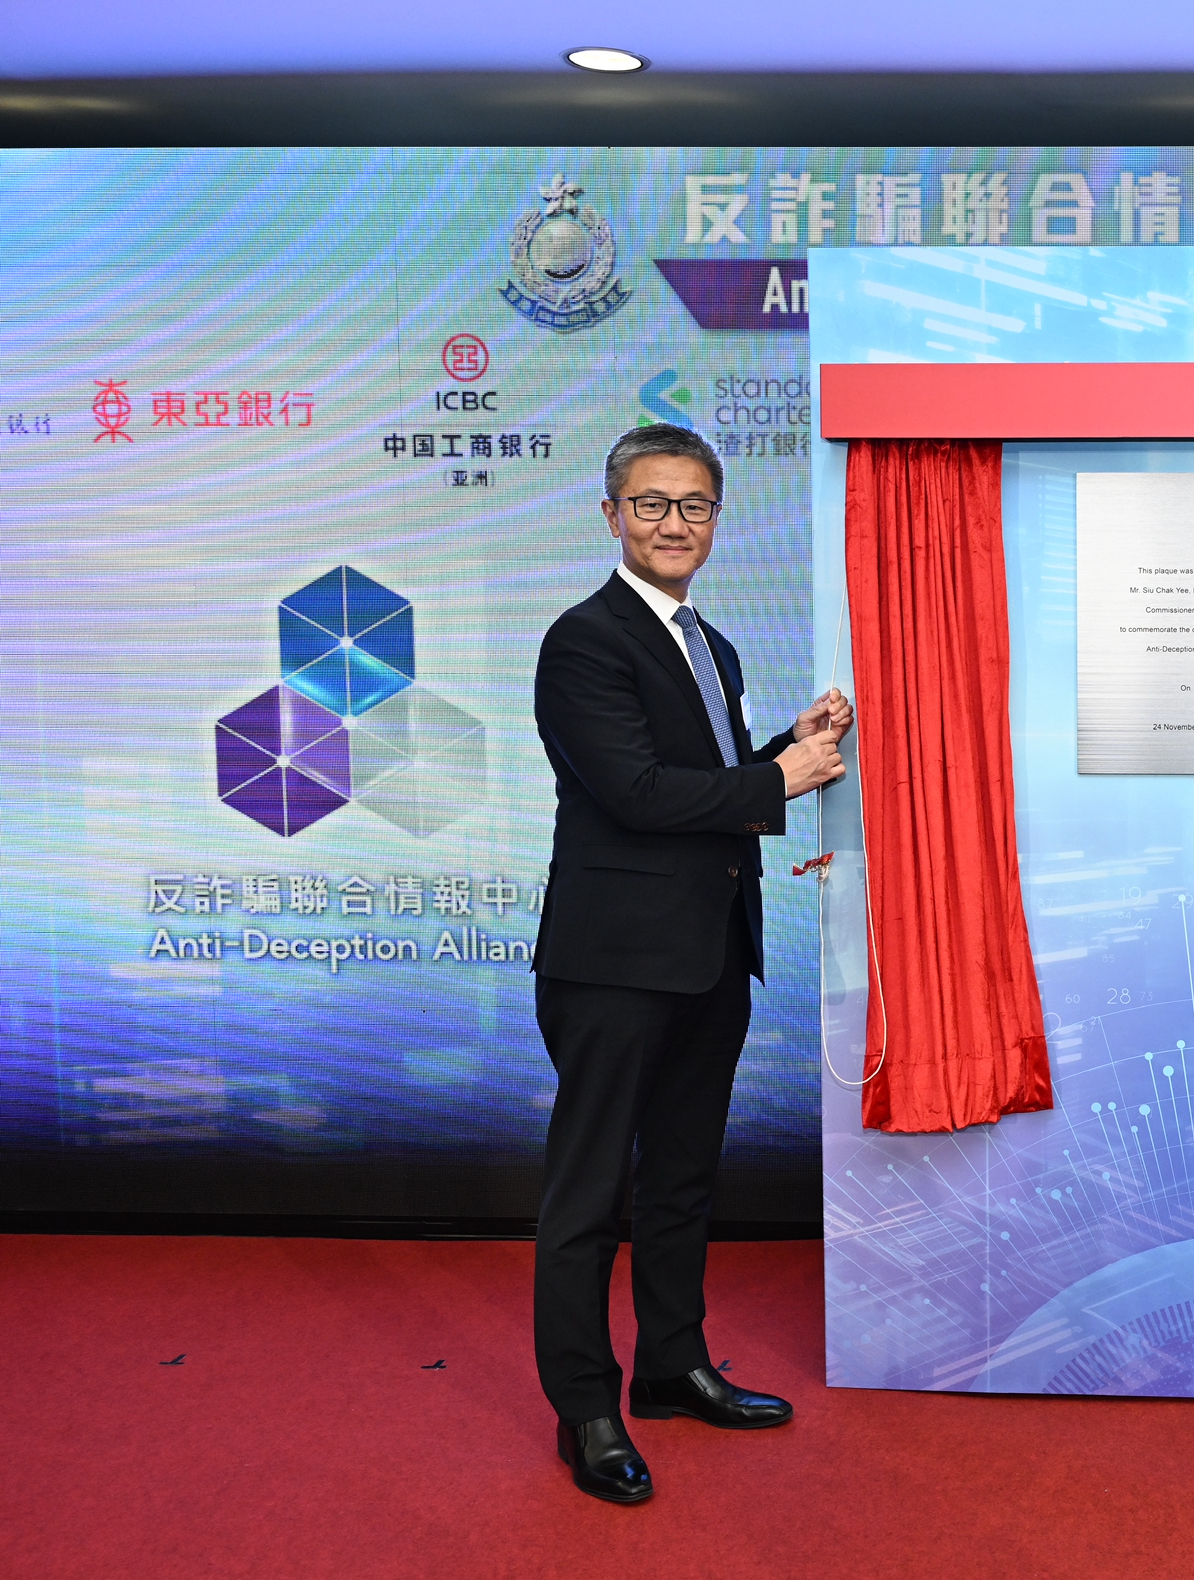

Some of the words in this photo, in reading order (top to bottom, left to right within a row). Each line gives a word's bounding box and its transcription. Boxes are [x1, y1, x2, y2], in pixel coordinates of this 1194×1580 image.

[715, 375, 810, 398] stand
[150, 390, 316, 427] 東亞銀行
[436, 391, 498, 412] ICBC
[383, 432, 552, 459] 中国工商银行
[1154, 567, 1178, 576] plaque
[1129, 586, 1141, 594] Mr.
[1142, 586, 1154, 594] Siu
[1156, 586, 1174, 594] Chak
[1175, 586, 1191, 595] Yee,
[1145, 606, 1194, 614] Commissioner
[1152, 723, 1162, 731] 24
[1119, 886, 1142, 906] 19
[1134, 918, 1152, 930] 47
[149, 927, 418, 974] Anti-Deception
[1065, 994, 1081, 1004] 60
[1106, 987, 1132, 1006] 28
[1140, 991, 1154, 1002] 73
